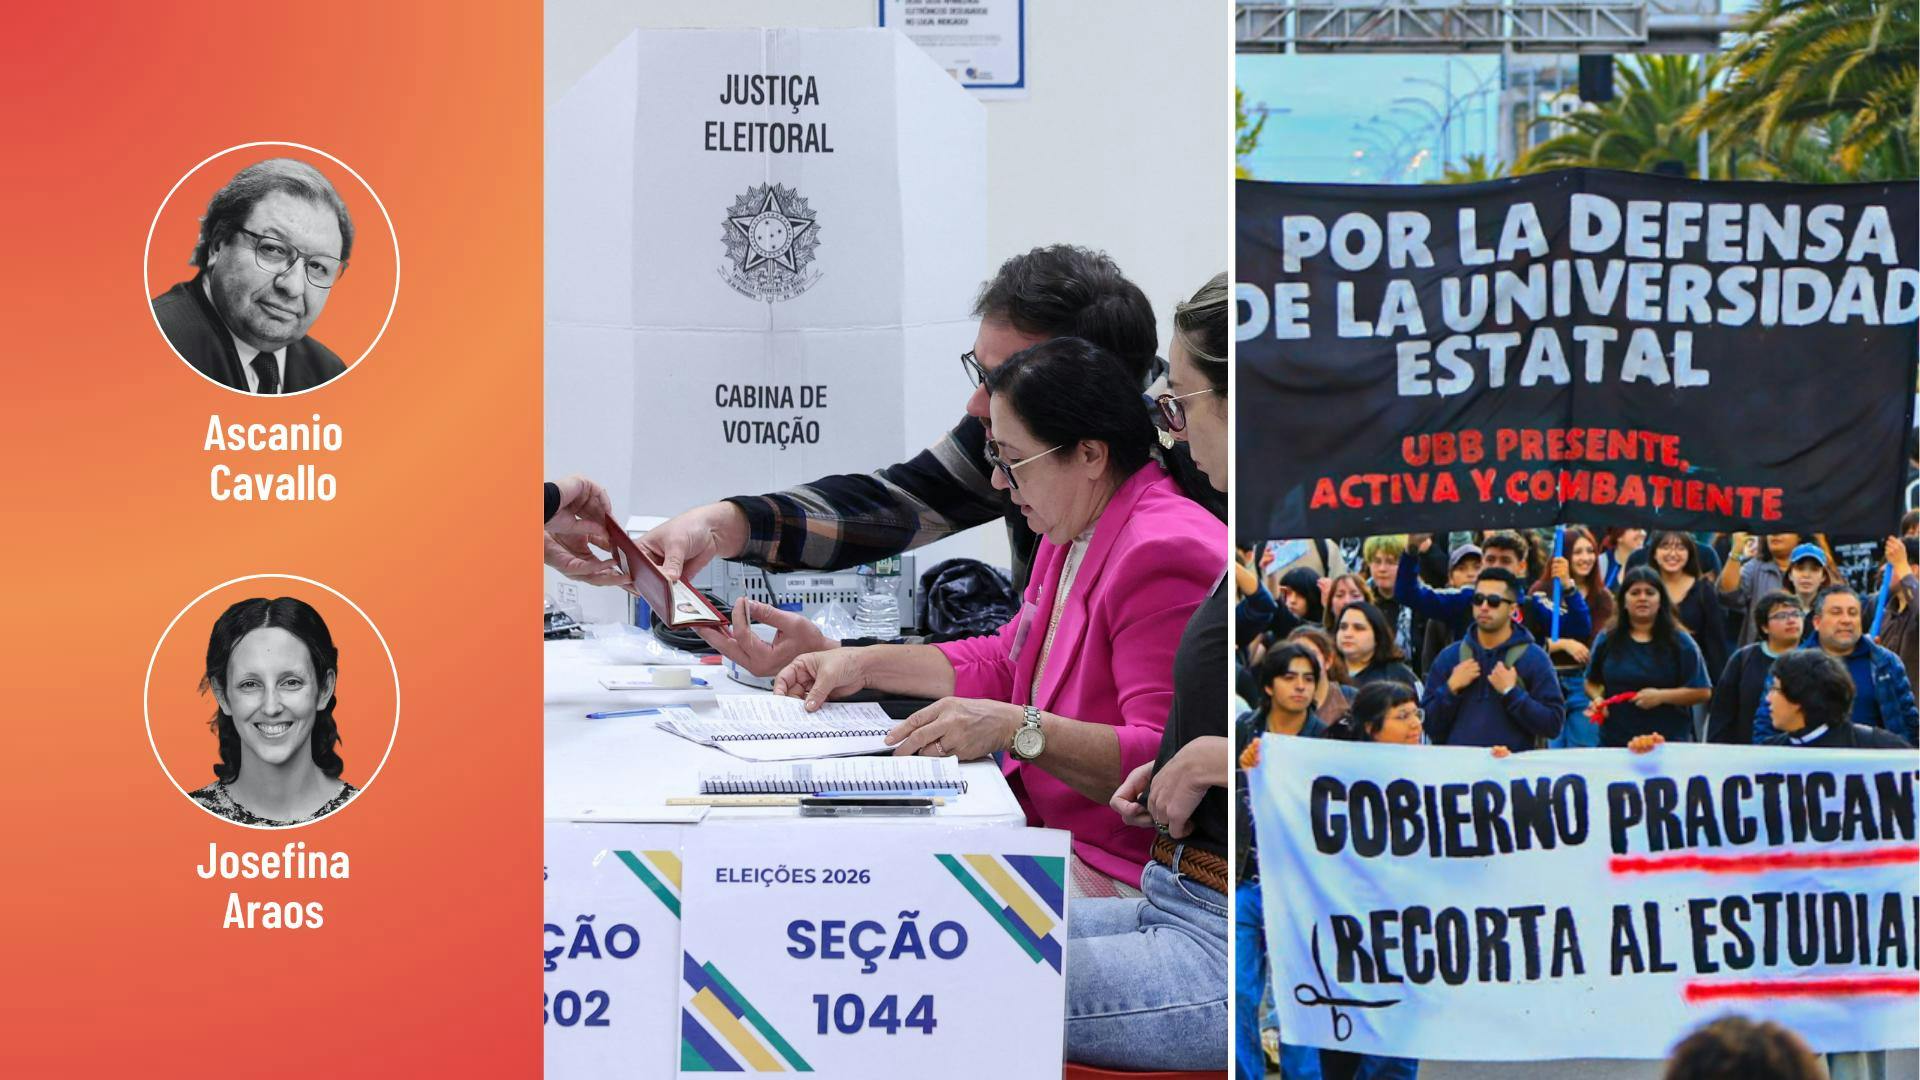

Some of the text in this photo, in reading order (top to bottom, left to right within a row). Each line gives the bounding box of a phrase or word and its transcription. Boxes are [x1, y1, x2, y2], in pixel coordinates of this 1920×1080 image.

[720, 74, 820, 114] JUSTIÇA
[704, 121, 835, 154] ELEITORAL
[1282, 192, 1899, 273] POR LA DEFENSA
[1235, 258, 1919, 342] DE LA UNIVERSIDAD
[1395, 325, 1710, 399] ESTATAL
[715, 384, 828, 409] CABINA DE
[722, 416, 821, 451] VOTAÇÃO
[1401, 427, 1691, 474] UBB PRESENTE,
[1309, 467, 1785, 522] ACTIVA Y COMBATIENTE
[1310, 770, 1919, 858] GOBIERNO PRACTICAN
[715, 865, 872, 888] ELEIÇÕES 2026
[786, 909, 969, 975] SEÇÃO
[1330, 891, 1919, 986] RECORTA AL ESTUDIA
[544, 989, 611, 1028] 02
[812, 992, 938, 1035] 1044
